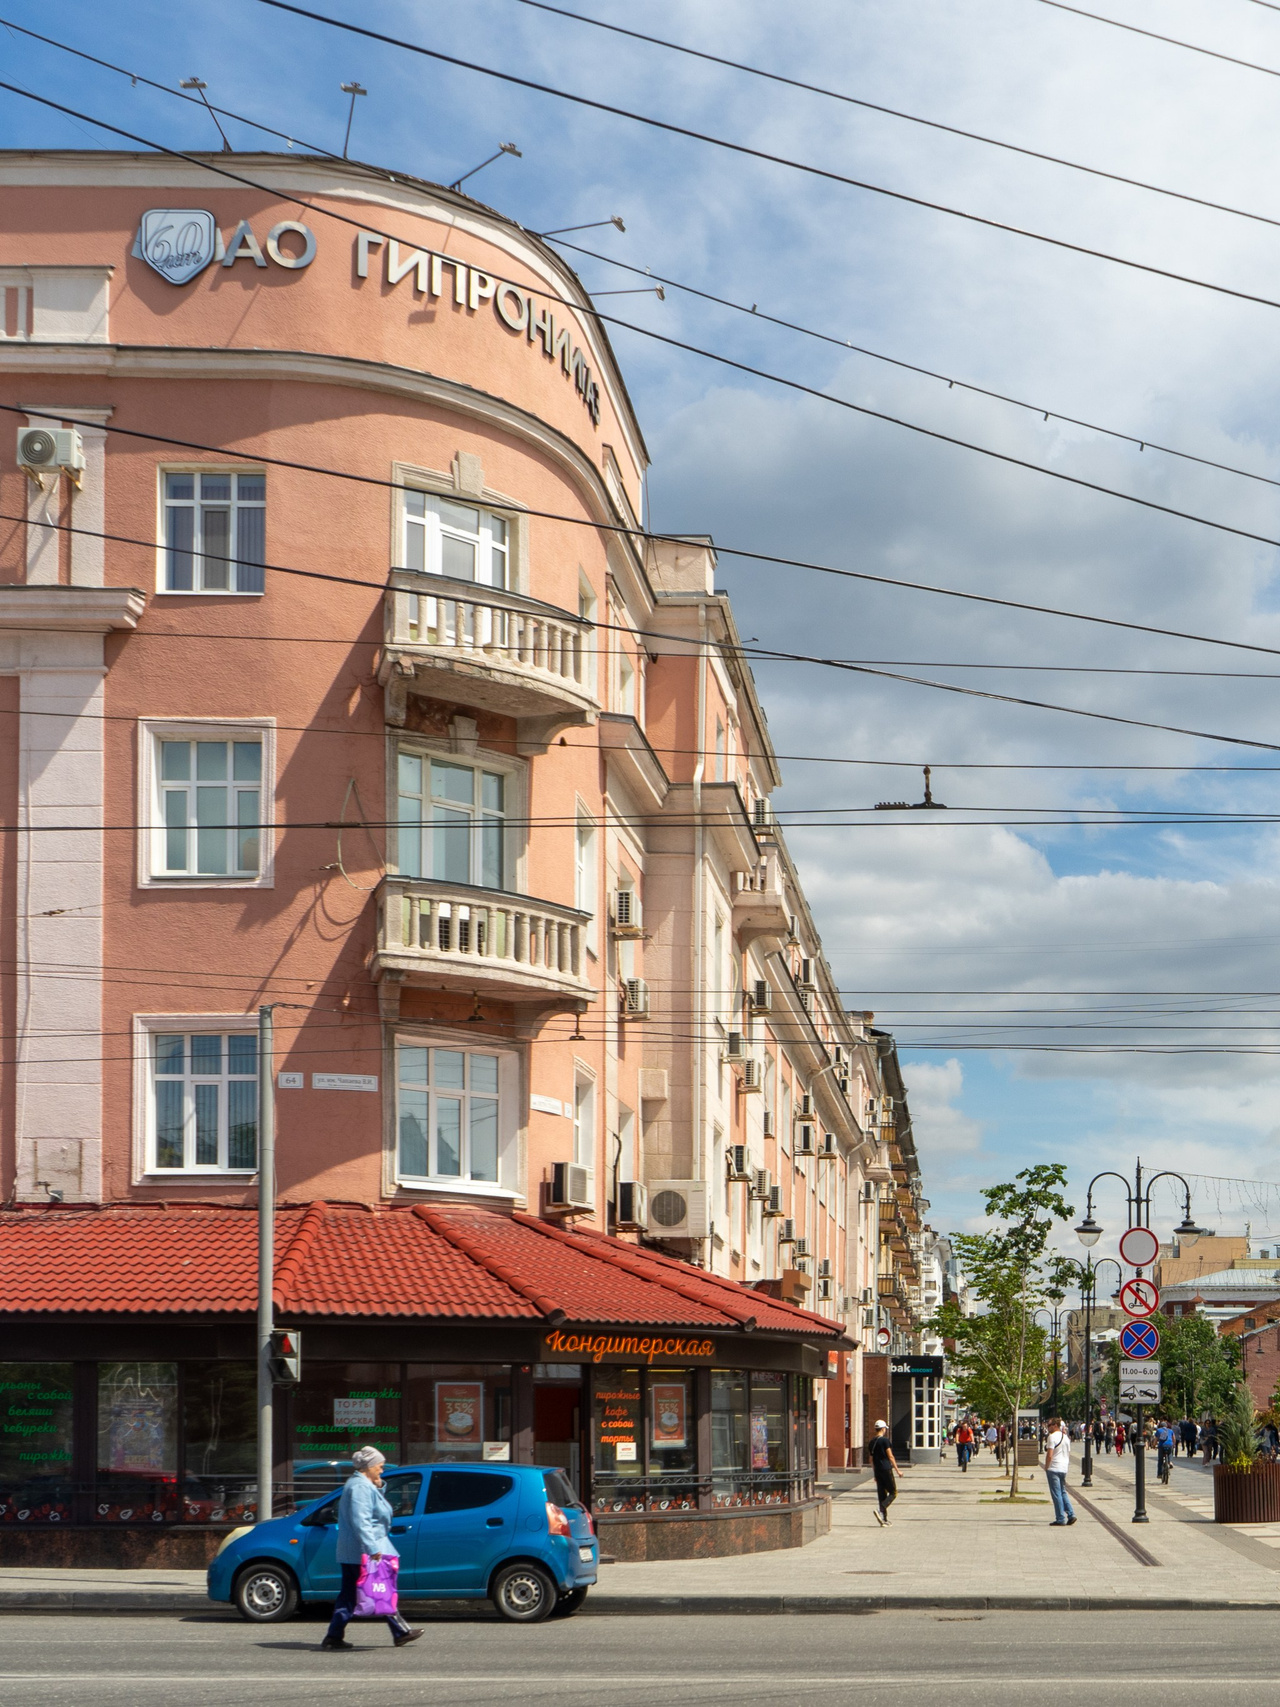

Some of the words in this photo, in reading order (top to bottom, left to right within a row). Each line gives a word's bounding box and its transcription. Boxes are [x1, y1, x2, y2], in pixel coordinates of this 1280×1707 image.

[147, 221, 204, 263] 60
[221, 219, 317, 269] АО
[357, 231, 600, 426] ГИПРОНИИГАЗ
[285, 1076, 297, 1085] 64
[1121, 1367, 1159, 1375] 11.00-6.00
[37, 1389, 73, 1400] собой
[348, 1388, 402, 1401] пирожки
[595, 1389, 641, 1403] пирожные
[8, 1405, 54, 1416] беляши
[338, 1400, 372, 1409] ТОРТЫ
[445, 1402, 474, 1414] 35%
[659, 1403, 679, 1414] 35%
[604, 1406, 629, 1420] кофе
[335, 1417, 374, 1425] МОСКВА
[608, 1419, 634, 1428] собой
[3, 1421, 58, 1437] чебуреки
[296, 1424, 346, 1437] горячие
[347, 1423, 399, 1437] бульоны
[299, 1442, 349, 1451] салаты
[600, 1435, 634, 1447] торты
[19, 1449, 73, 1464] пирожки
